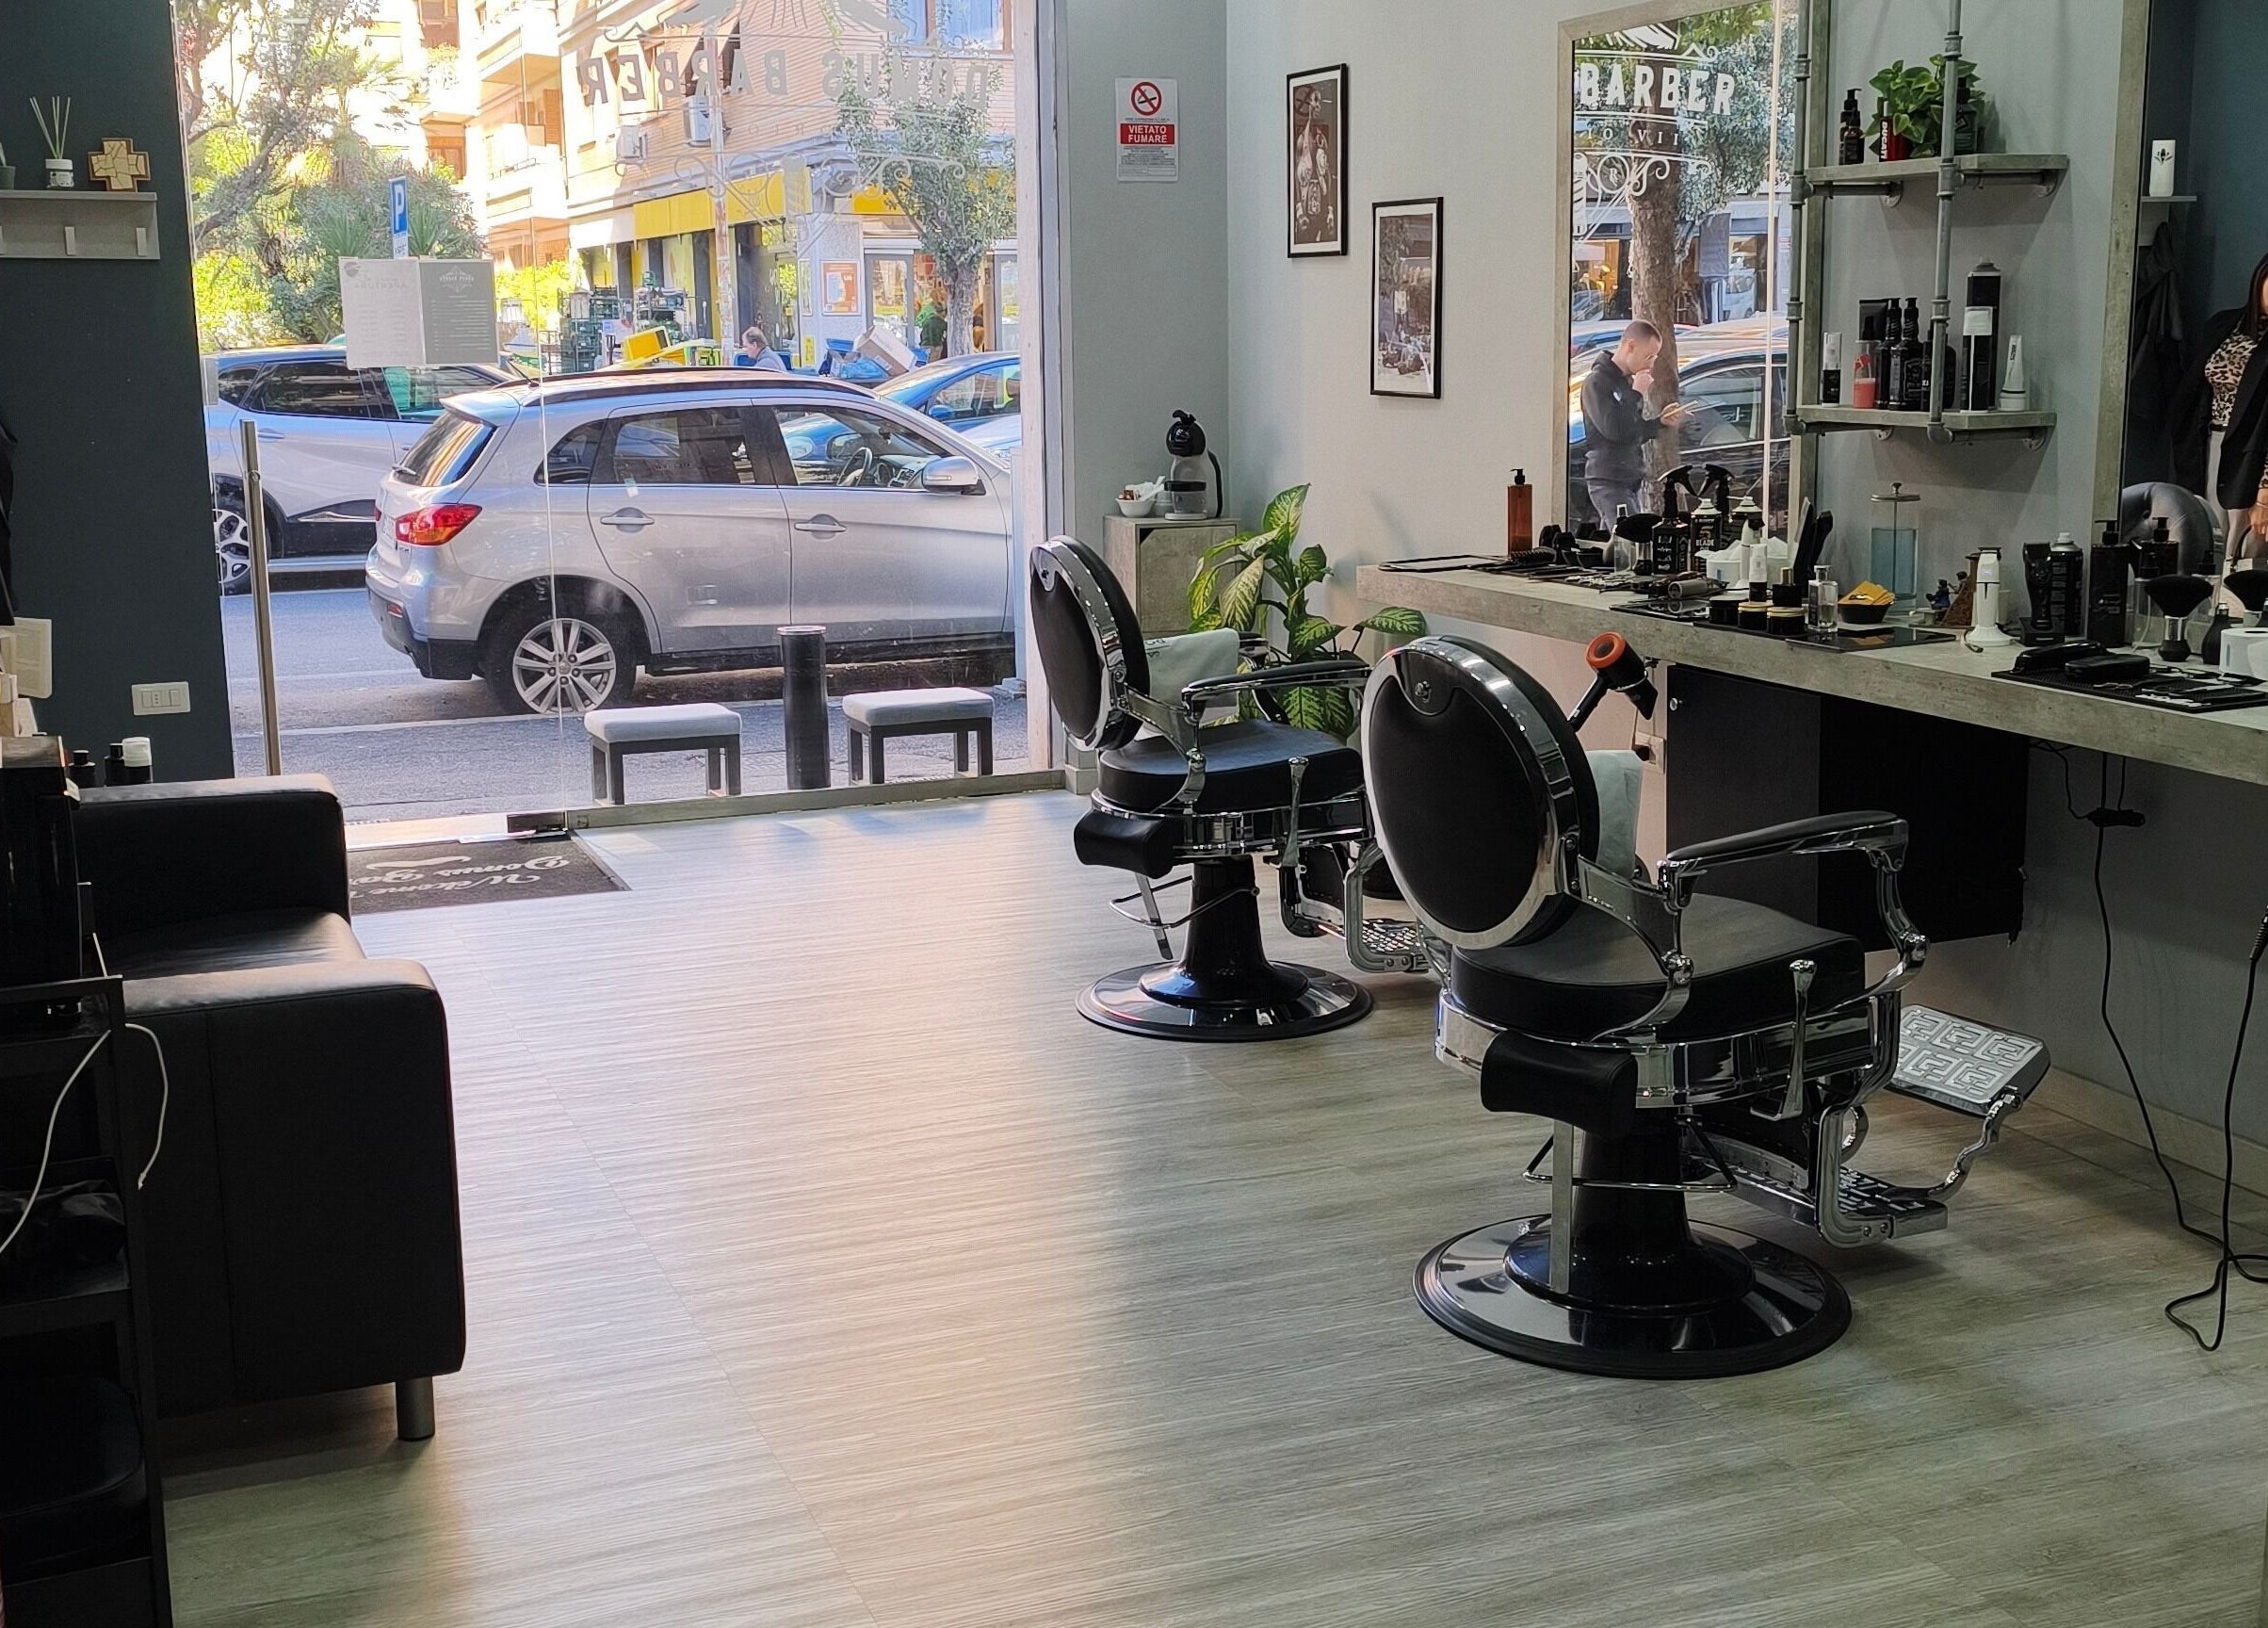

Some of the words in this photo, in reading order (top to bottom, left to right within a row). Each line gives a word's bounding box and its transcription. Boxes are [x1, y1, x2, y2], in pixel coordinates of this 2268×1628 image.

[1580, 62, 1736, 116] BARBER
[1127, 134, 1168, 143] FUMARE
[1128, 124, 1167, 134] VIETATO
[1637, 129, 1679, 146] VII
[394, 184, 405, 231] P
[432, 855, 571, 877] Domus
